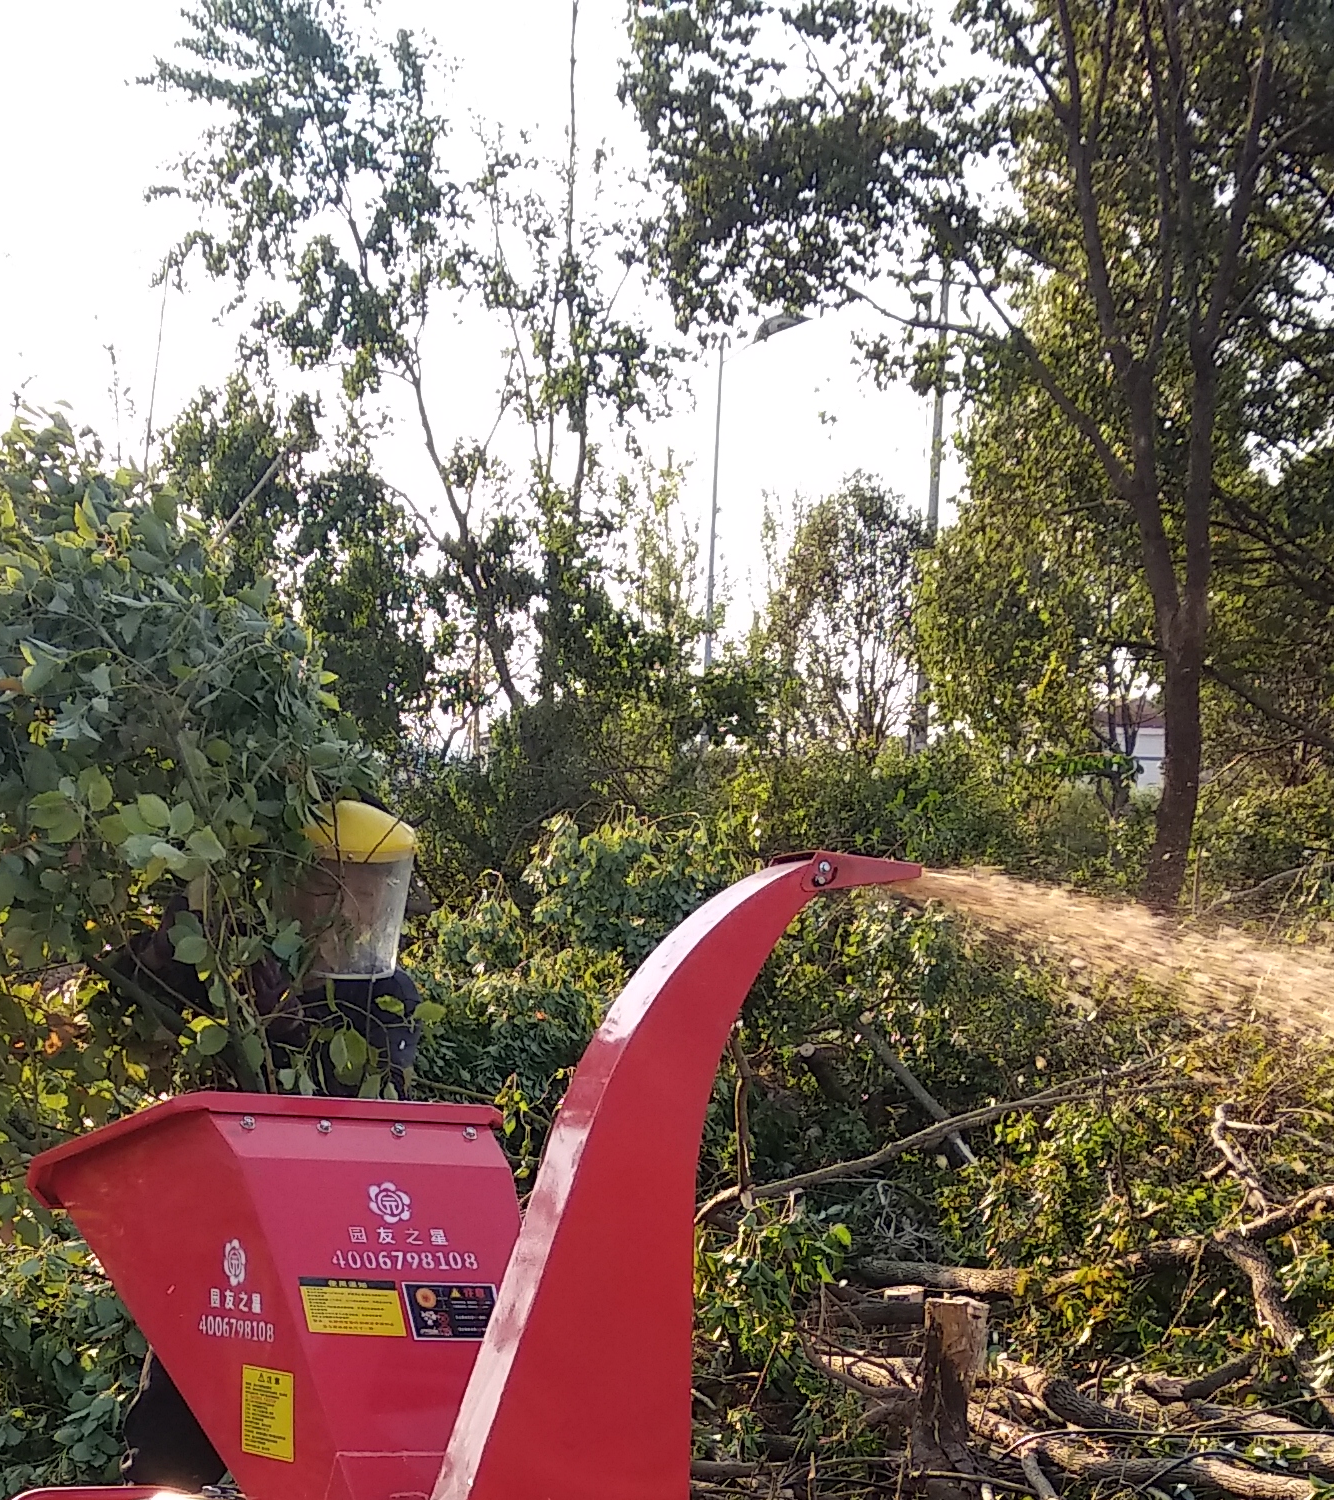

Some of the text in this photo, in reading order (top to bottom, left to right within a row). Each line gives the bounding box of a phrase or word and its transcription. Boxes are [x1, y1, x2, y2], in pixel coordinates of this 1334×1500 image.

[348, 1226, 449, 1246] 园友之星
[332, 1250, 479, 1270] 4006798108
[199, 1314, 275, 1343] 4006798108
